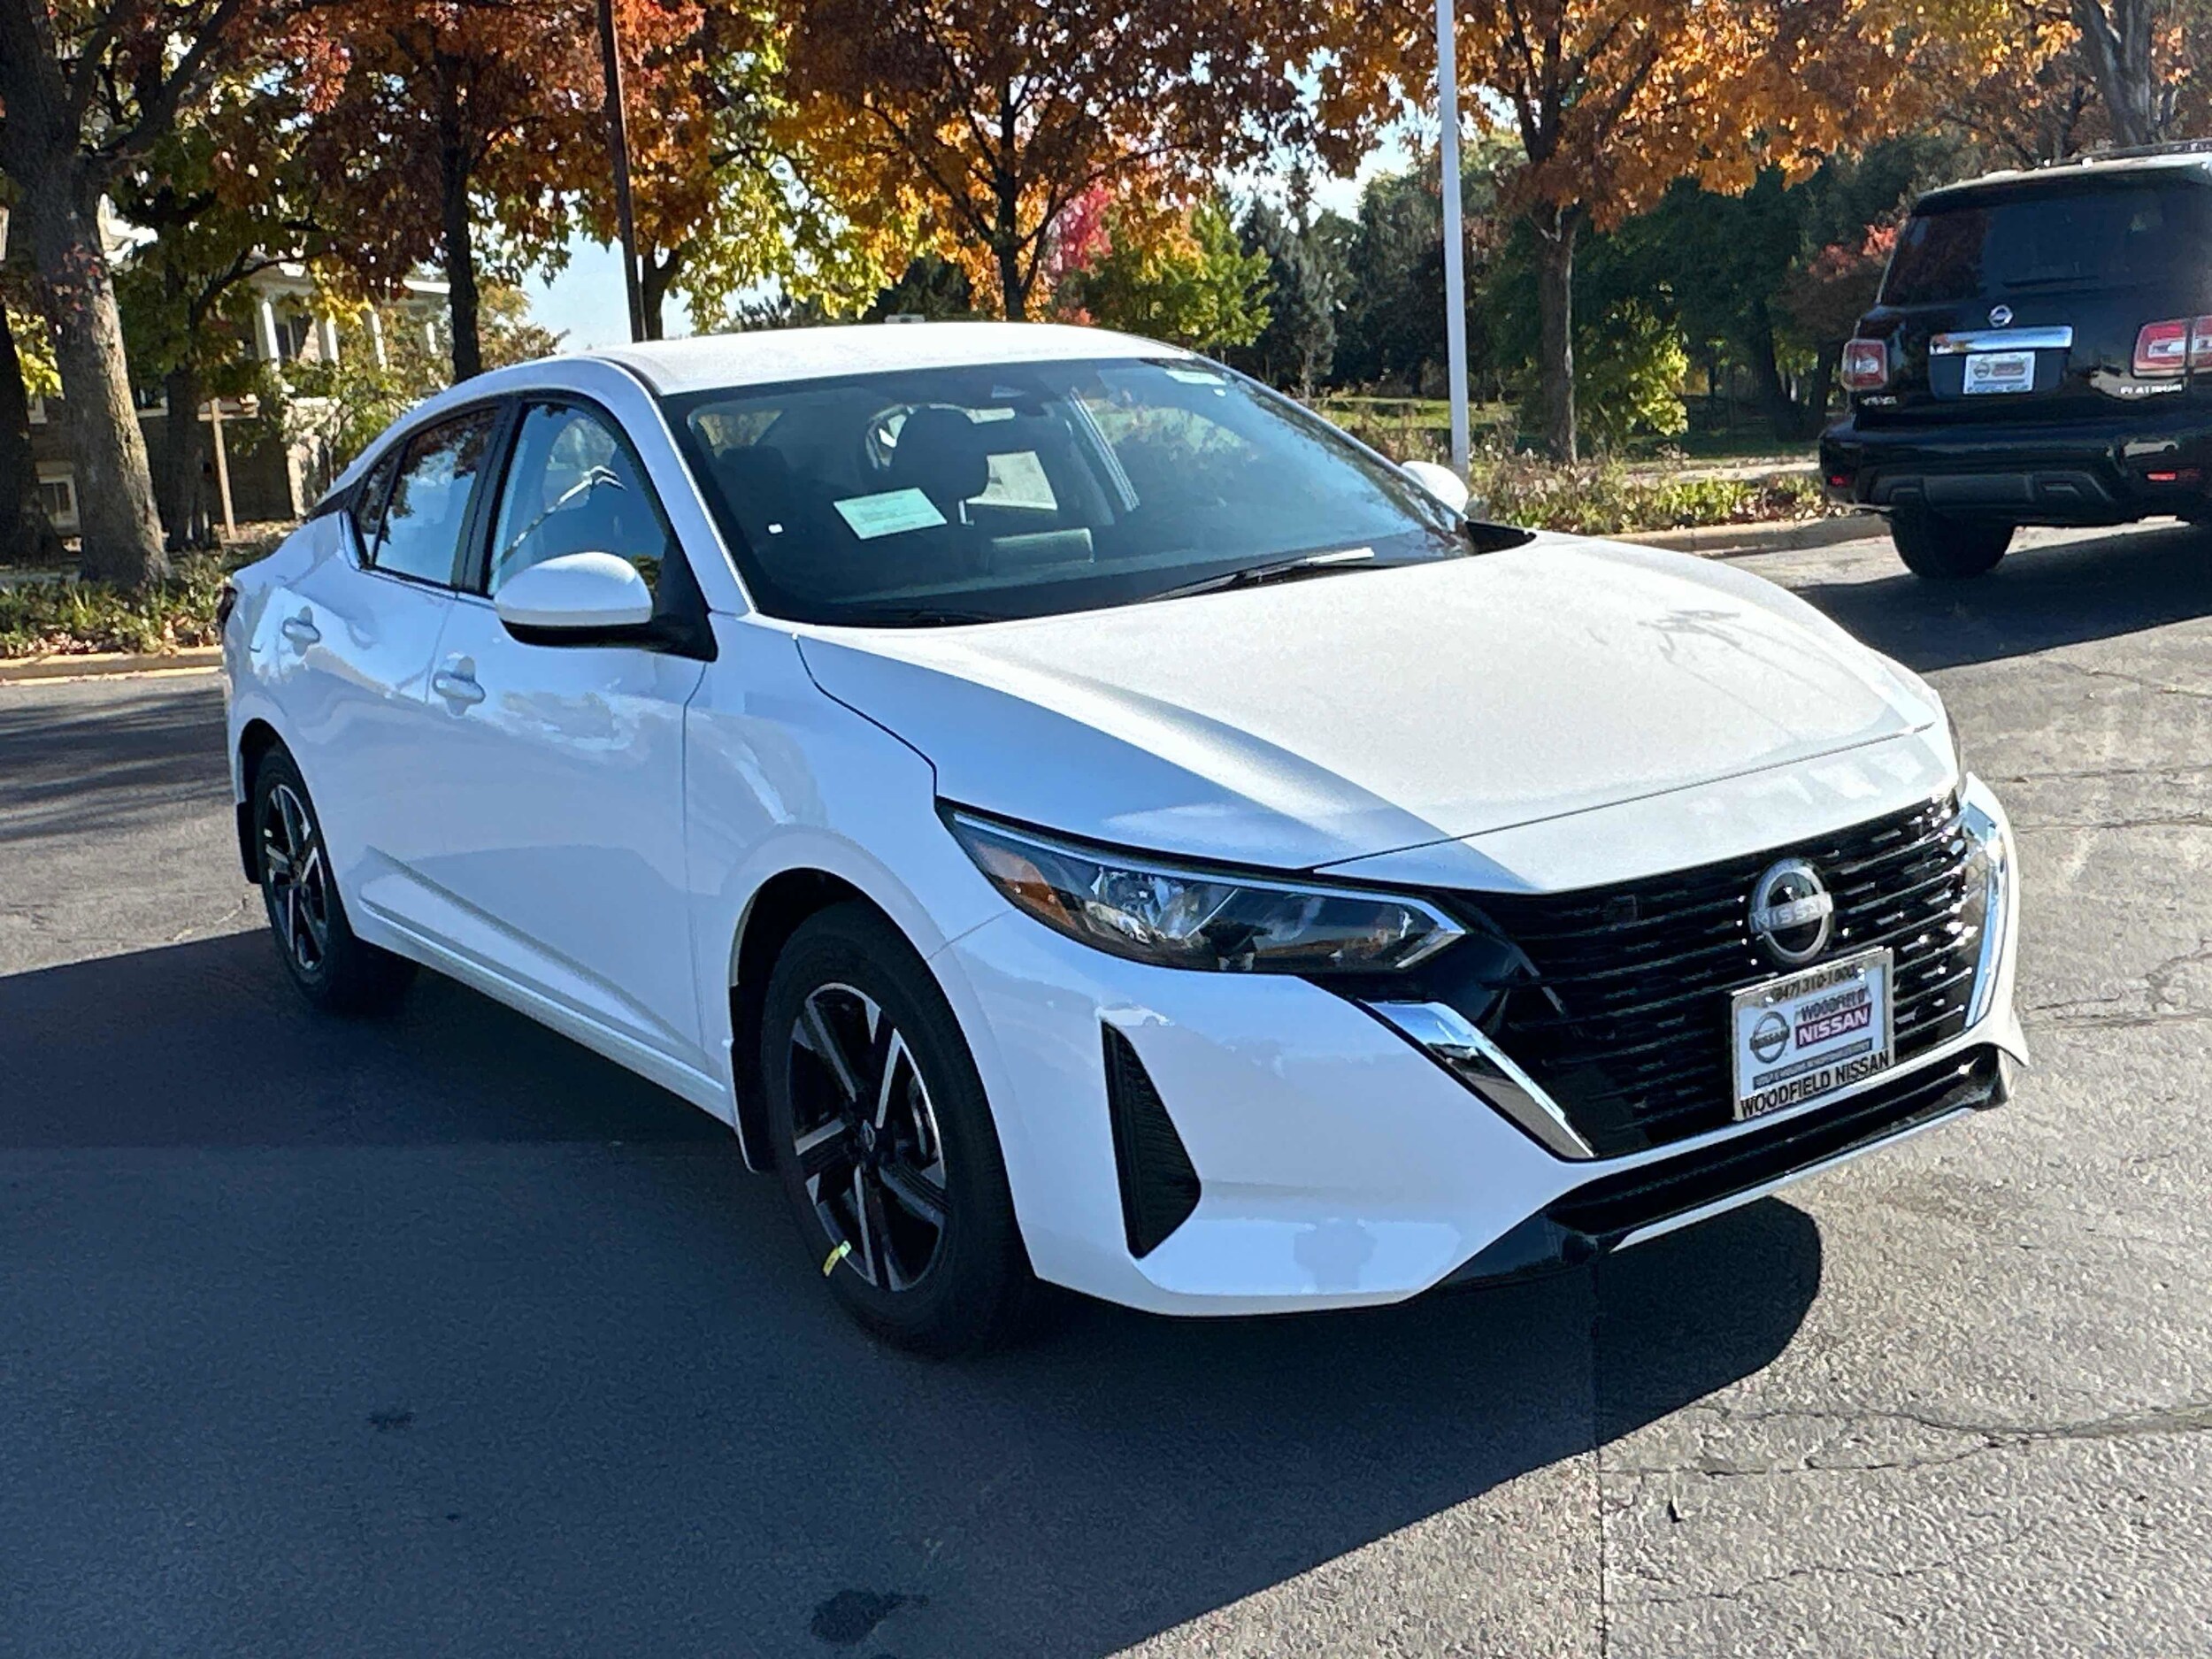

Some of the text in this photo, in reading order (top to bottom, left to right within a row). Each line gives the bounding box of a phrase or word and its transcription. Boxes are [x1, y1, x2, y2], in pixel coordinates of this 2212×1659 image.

[1799, 1007, 1869, 1045] NISSAN
[1740, 1072, 1831, 1118] WOODFIELD
[1836, 1049, 1890, 1083] NISSAN
